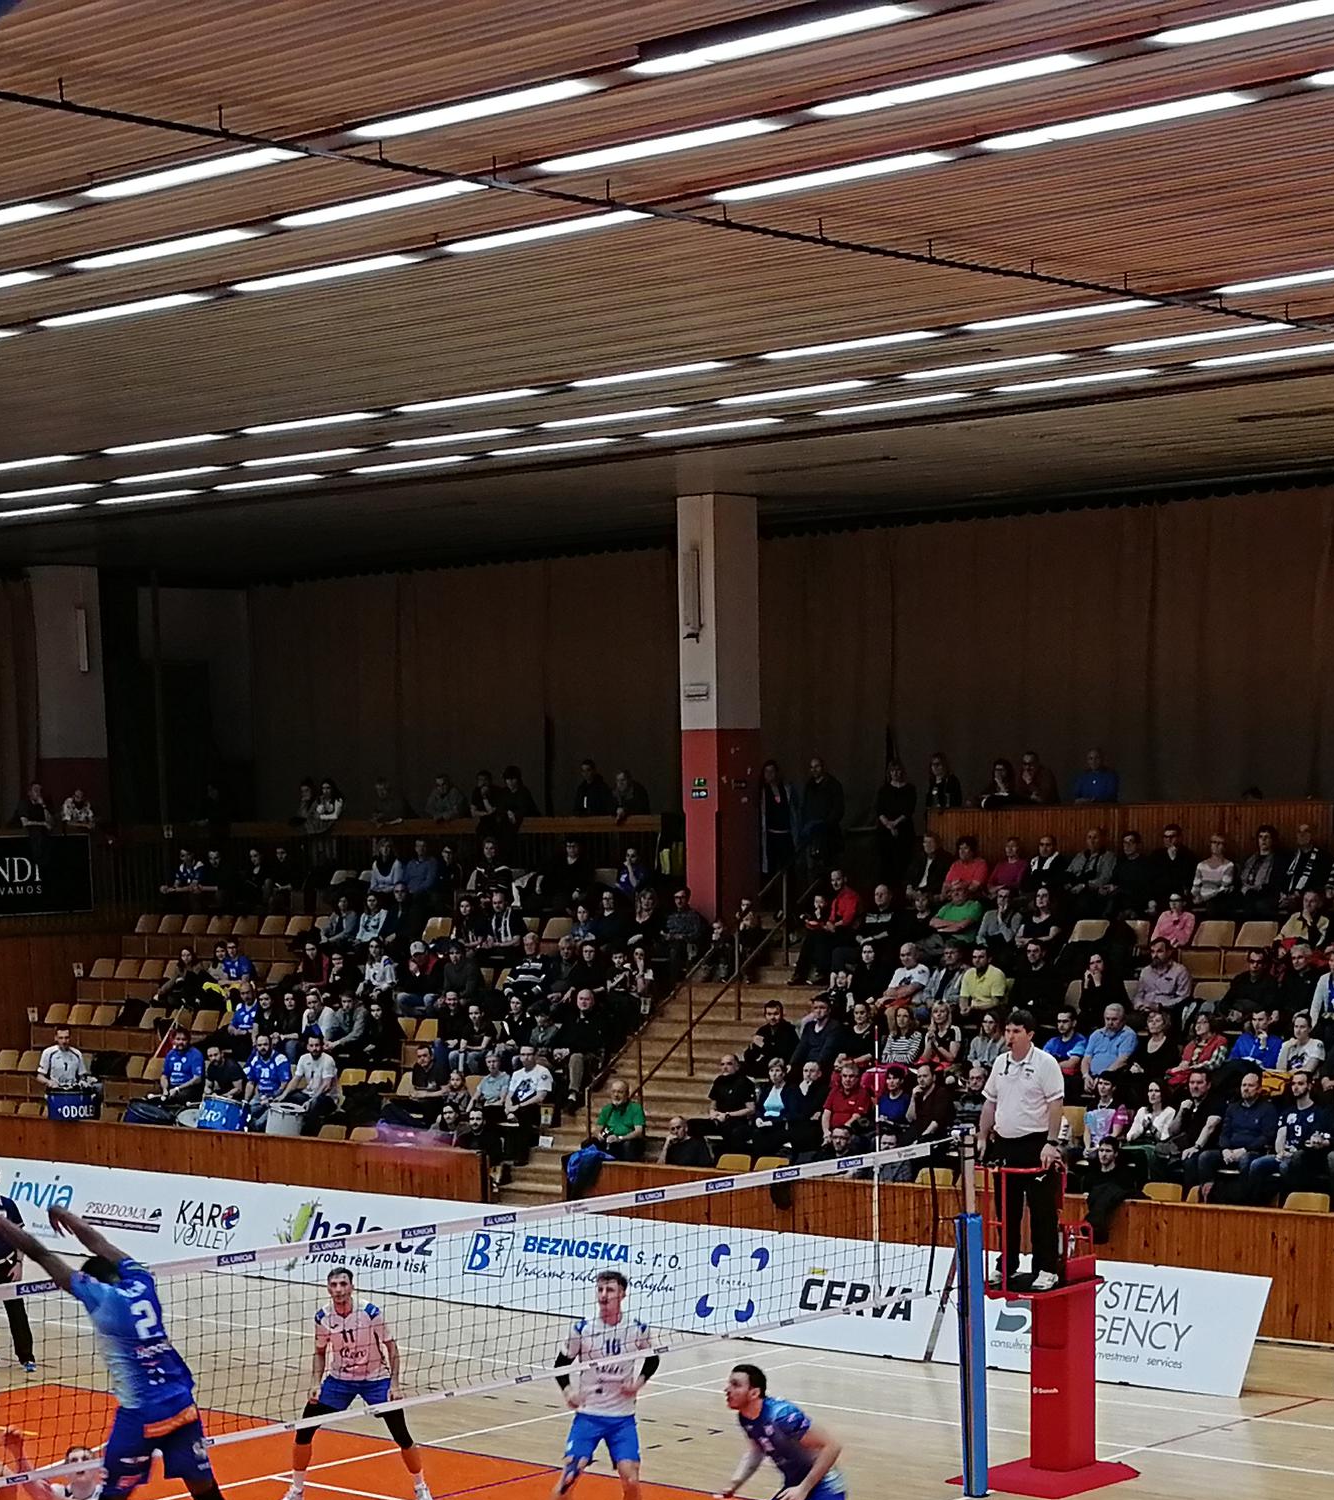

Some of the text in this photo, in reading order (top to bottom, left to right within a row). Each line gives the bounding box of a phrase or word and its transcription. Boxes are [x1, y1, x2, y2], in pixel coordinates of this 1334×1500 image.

[10, 1172, 73, 1211] invia
[85, 1201, 146, 1220] PRODOMA
[172, 1226, 235, 1250] VOLLEY
[523, 1235, 629, 1263] BEZNOSKA
[349, 1255, 393, 1270] reklam
[403, 1260, 428, 1274] tisk
[130, 1300, 164, 1340] 2
[1097, 1352, 1183, 1369] nvestment services
